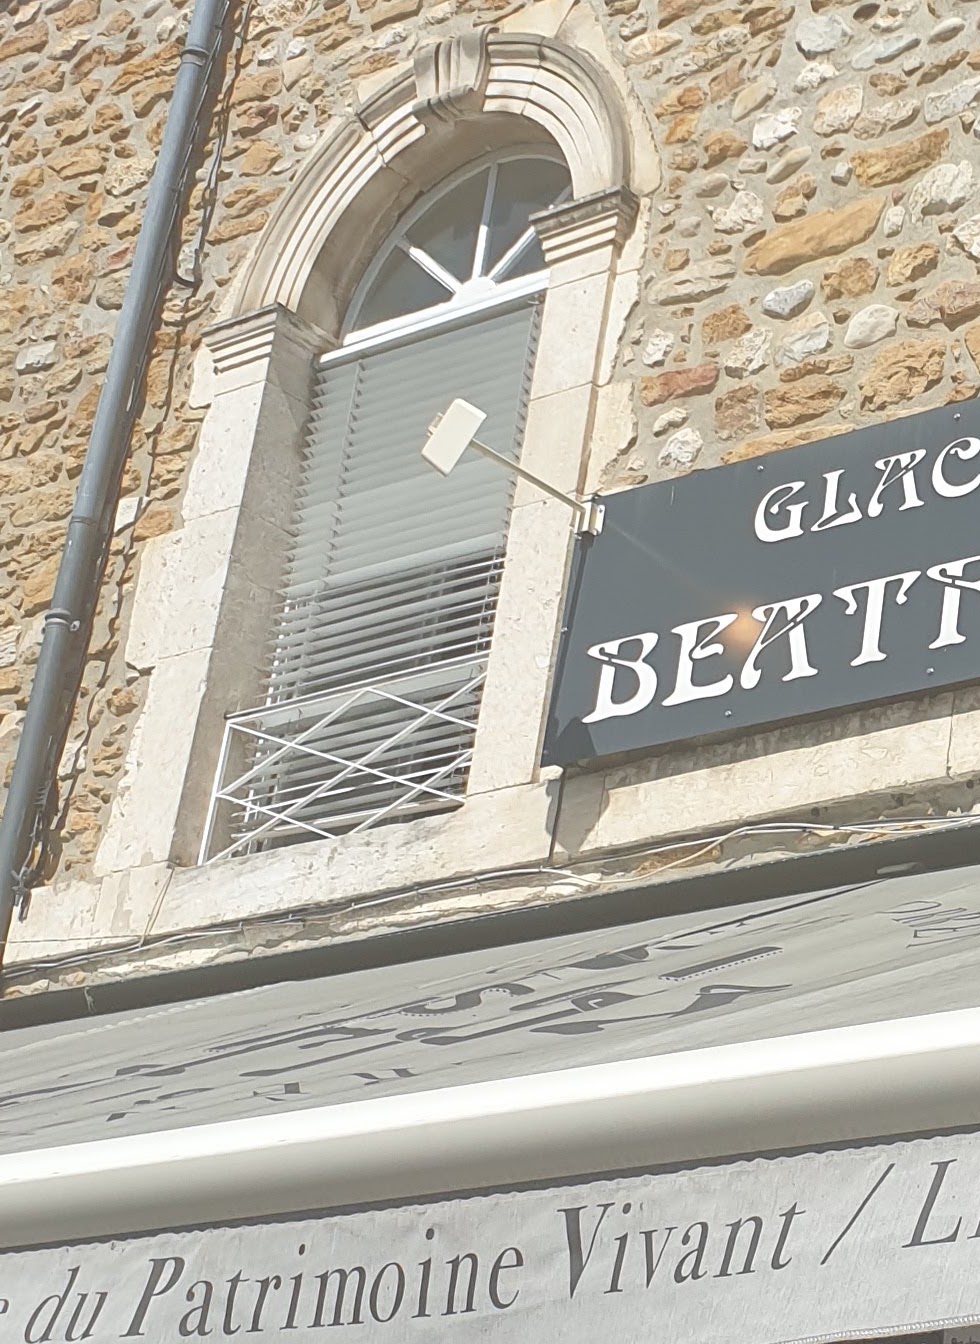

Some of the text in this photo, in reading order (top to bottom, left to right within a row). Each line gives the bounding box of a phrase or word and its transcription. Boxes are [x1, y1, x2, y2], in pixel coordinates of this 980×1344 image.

[24, 1265, 108, 1344] du
[119, 1229, 524, 1338] Patrimoine
[557, 1202, 806, 1303] Vivant
